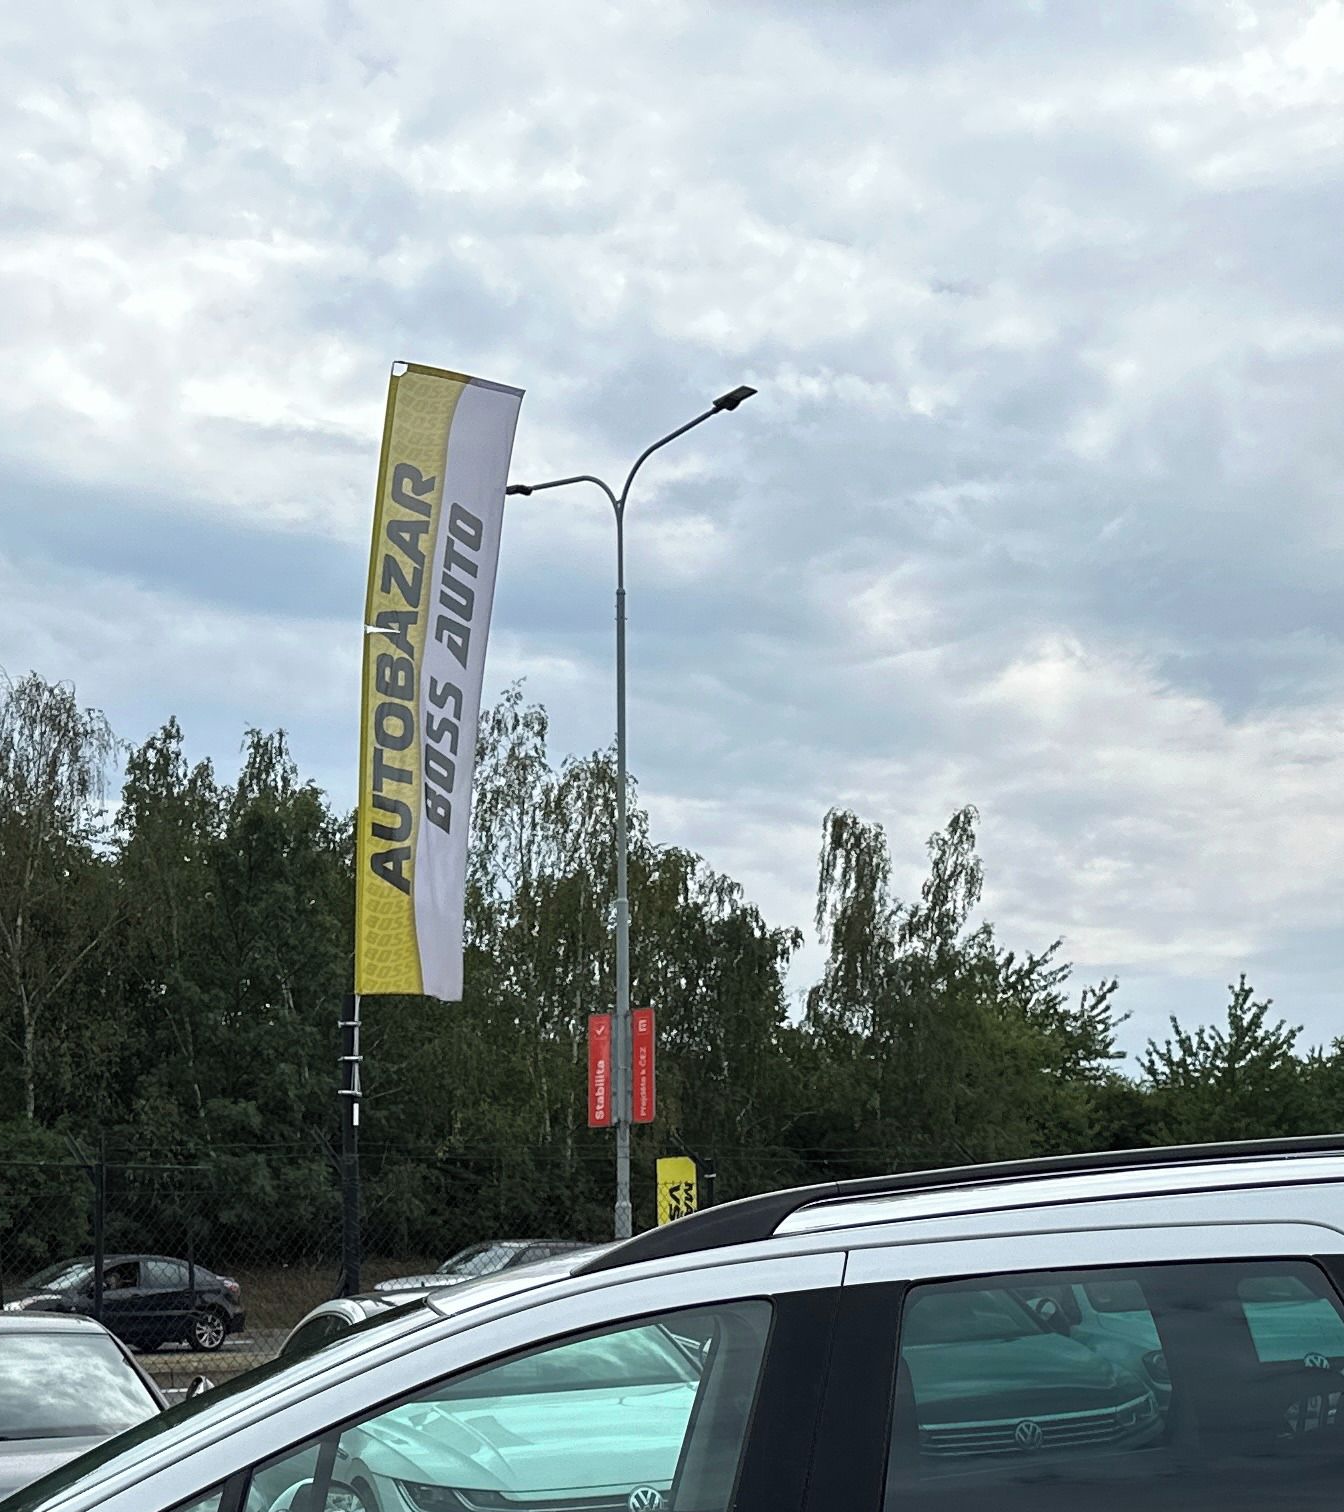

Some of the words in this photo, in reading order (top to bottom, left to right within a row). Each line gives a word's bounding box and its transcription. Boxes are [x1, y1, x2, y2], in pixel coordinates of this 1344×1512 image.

[434, 502, 484, 670] AUTO
[370, 461, 436, 895] AUTOBAZAR
[423, 675, 464, 836] BOSS
[595, 1059, 605, 1120] Stabilita
